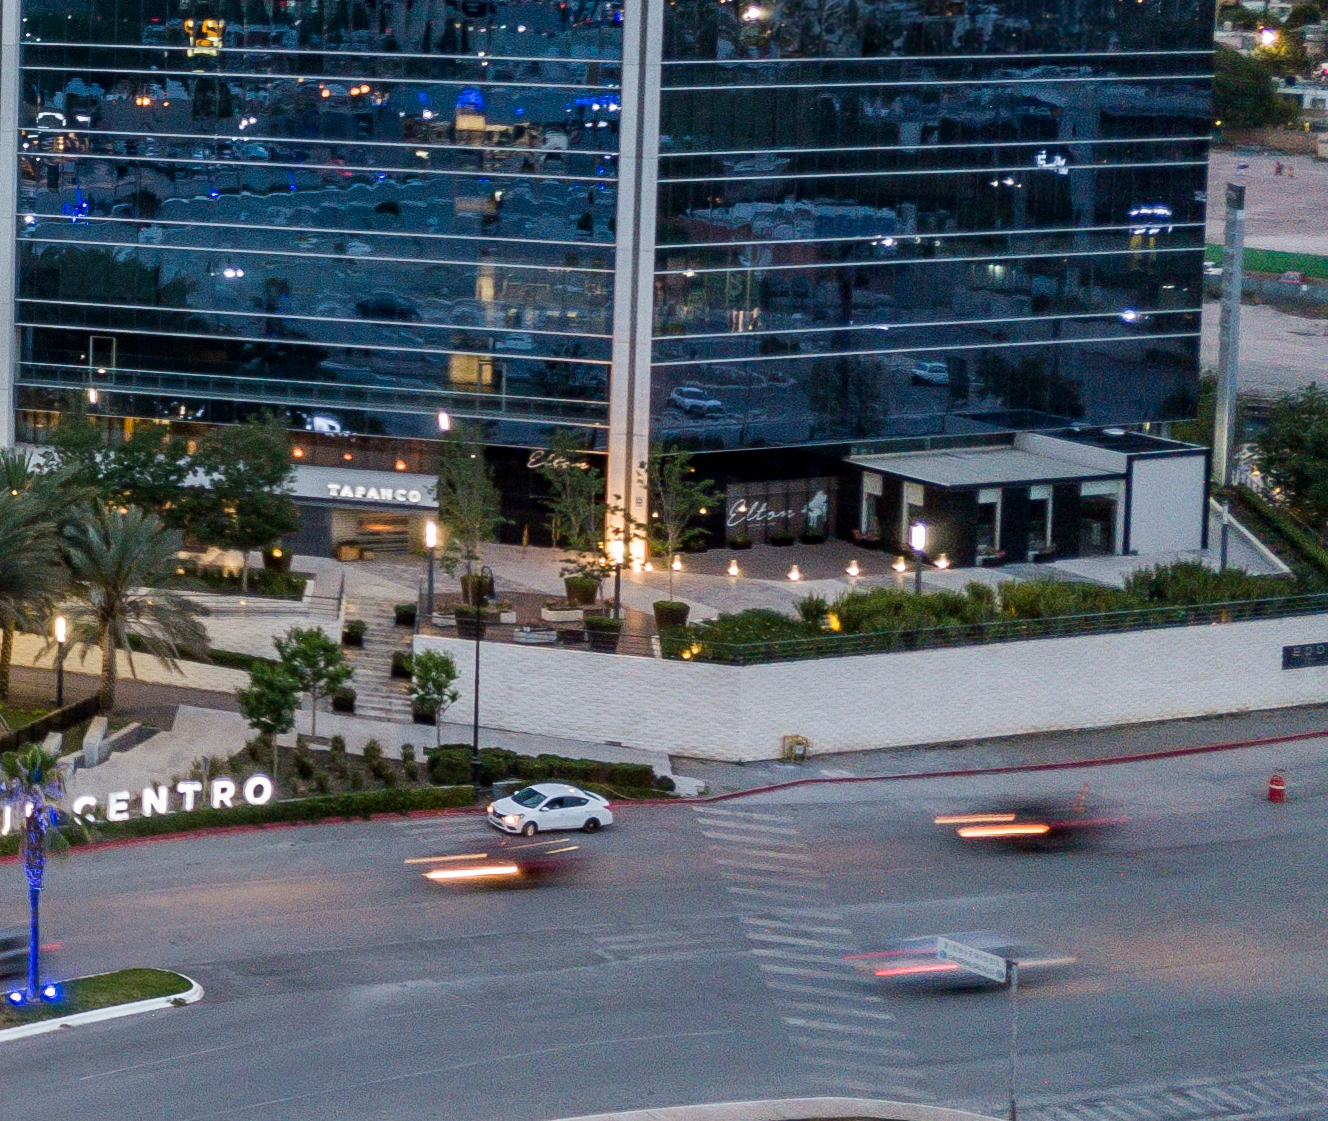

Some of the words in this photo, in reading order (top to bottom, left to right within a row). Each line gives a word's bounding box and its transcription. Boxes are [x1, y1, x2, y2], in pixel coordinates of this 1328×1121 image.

[326, 483, 422, 503] TAPANCO
[726, 498, 796, 527] Elton
[71, 773, 275, 826] CENTRO
